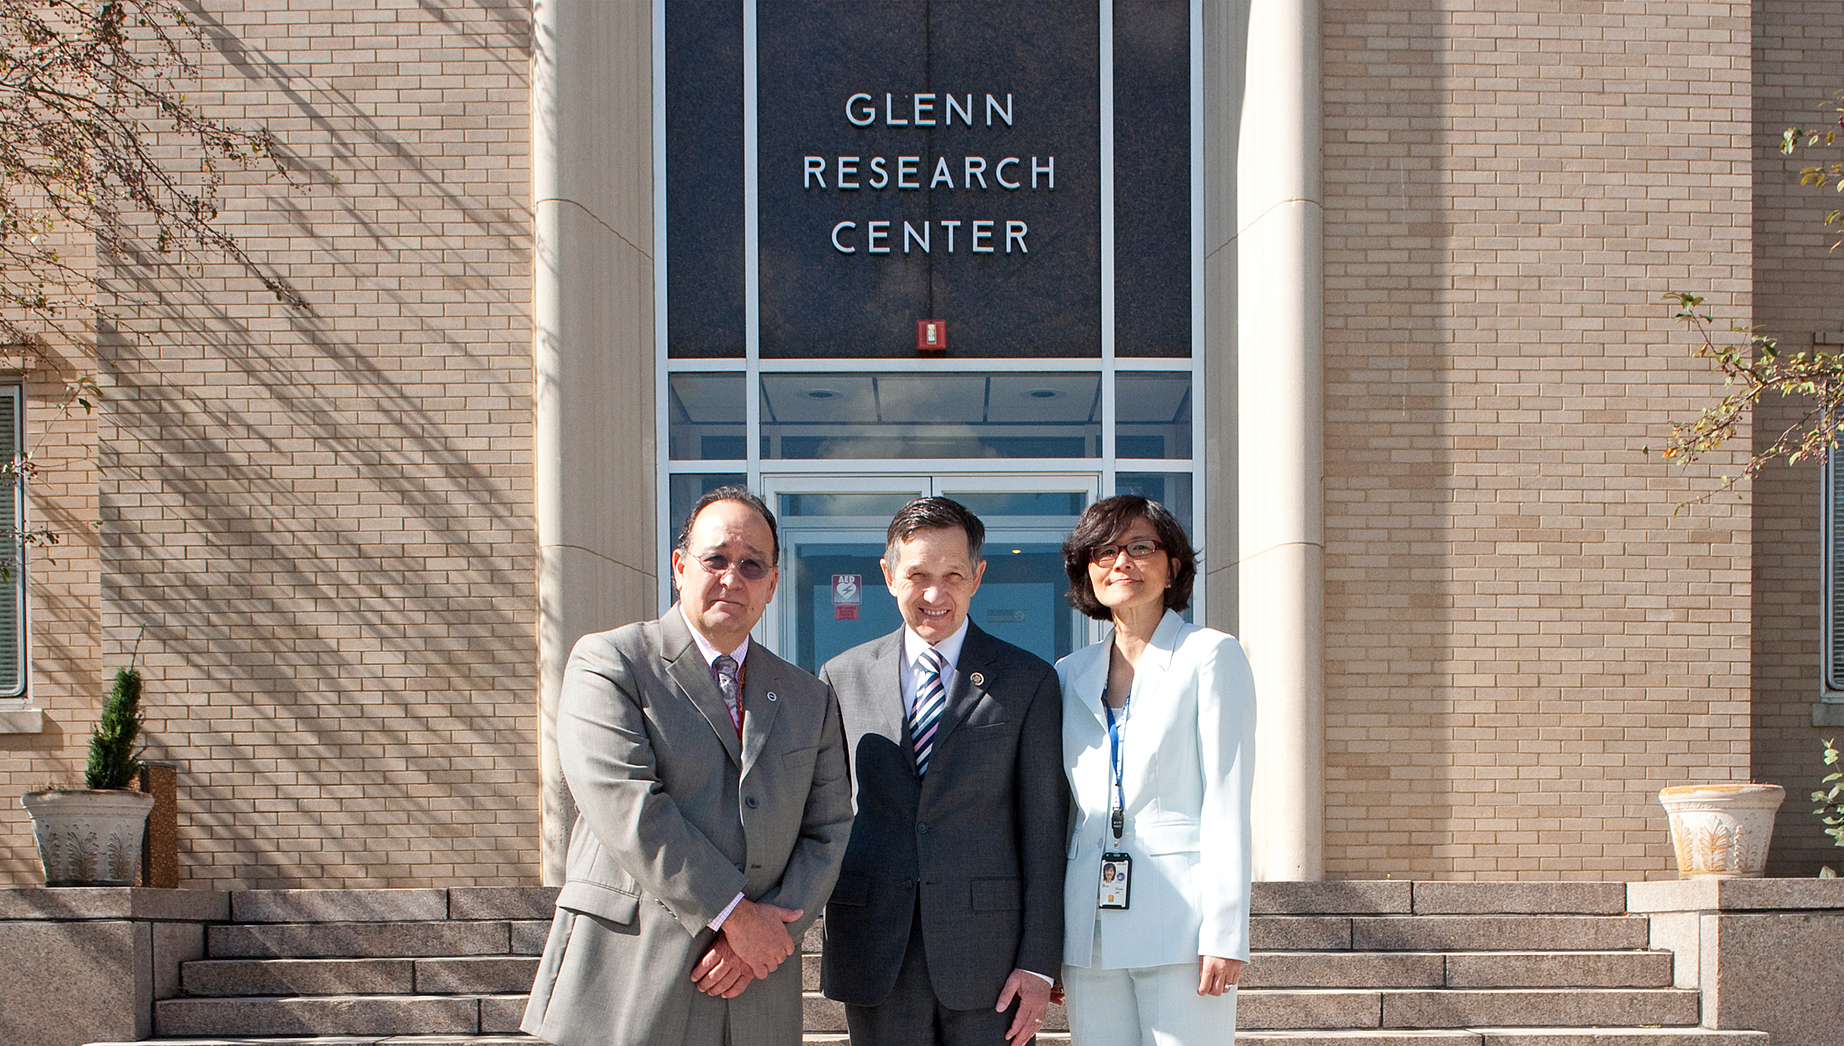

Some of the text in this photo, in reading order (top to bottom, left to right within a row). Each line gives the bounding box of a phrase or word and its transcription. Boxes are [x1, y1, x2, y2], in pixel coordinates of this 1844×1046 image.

[845, 93, 1013, 126] GLENN
[803, 156, 1054, 189] RESEARCH
[831, 220, 1028, 253] CENTER
[838, 575, 856, 583] AED
